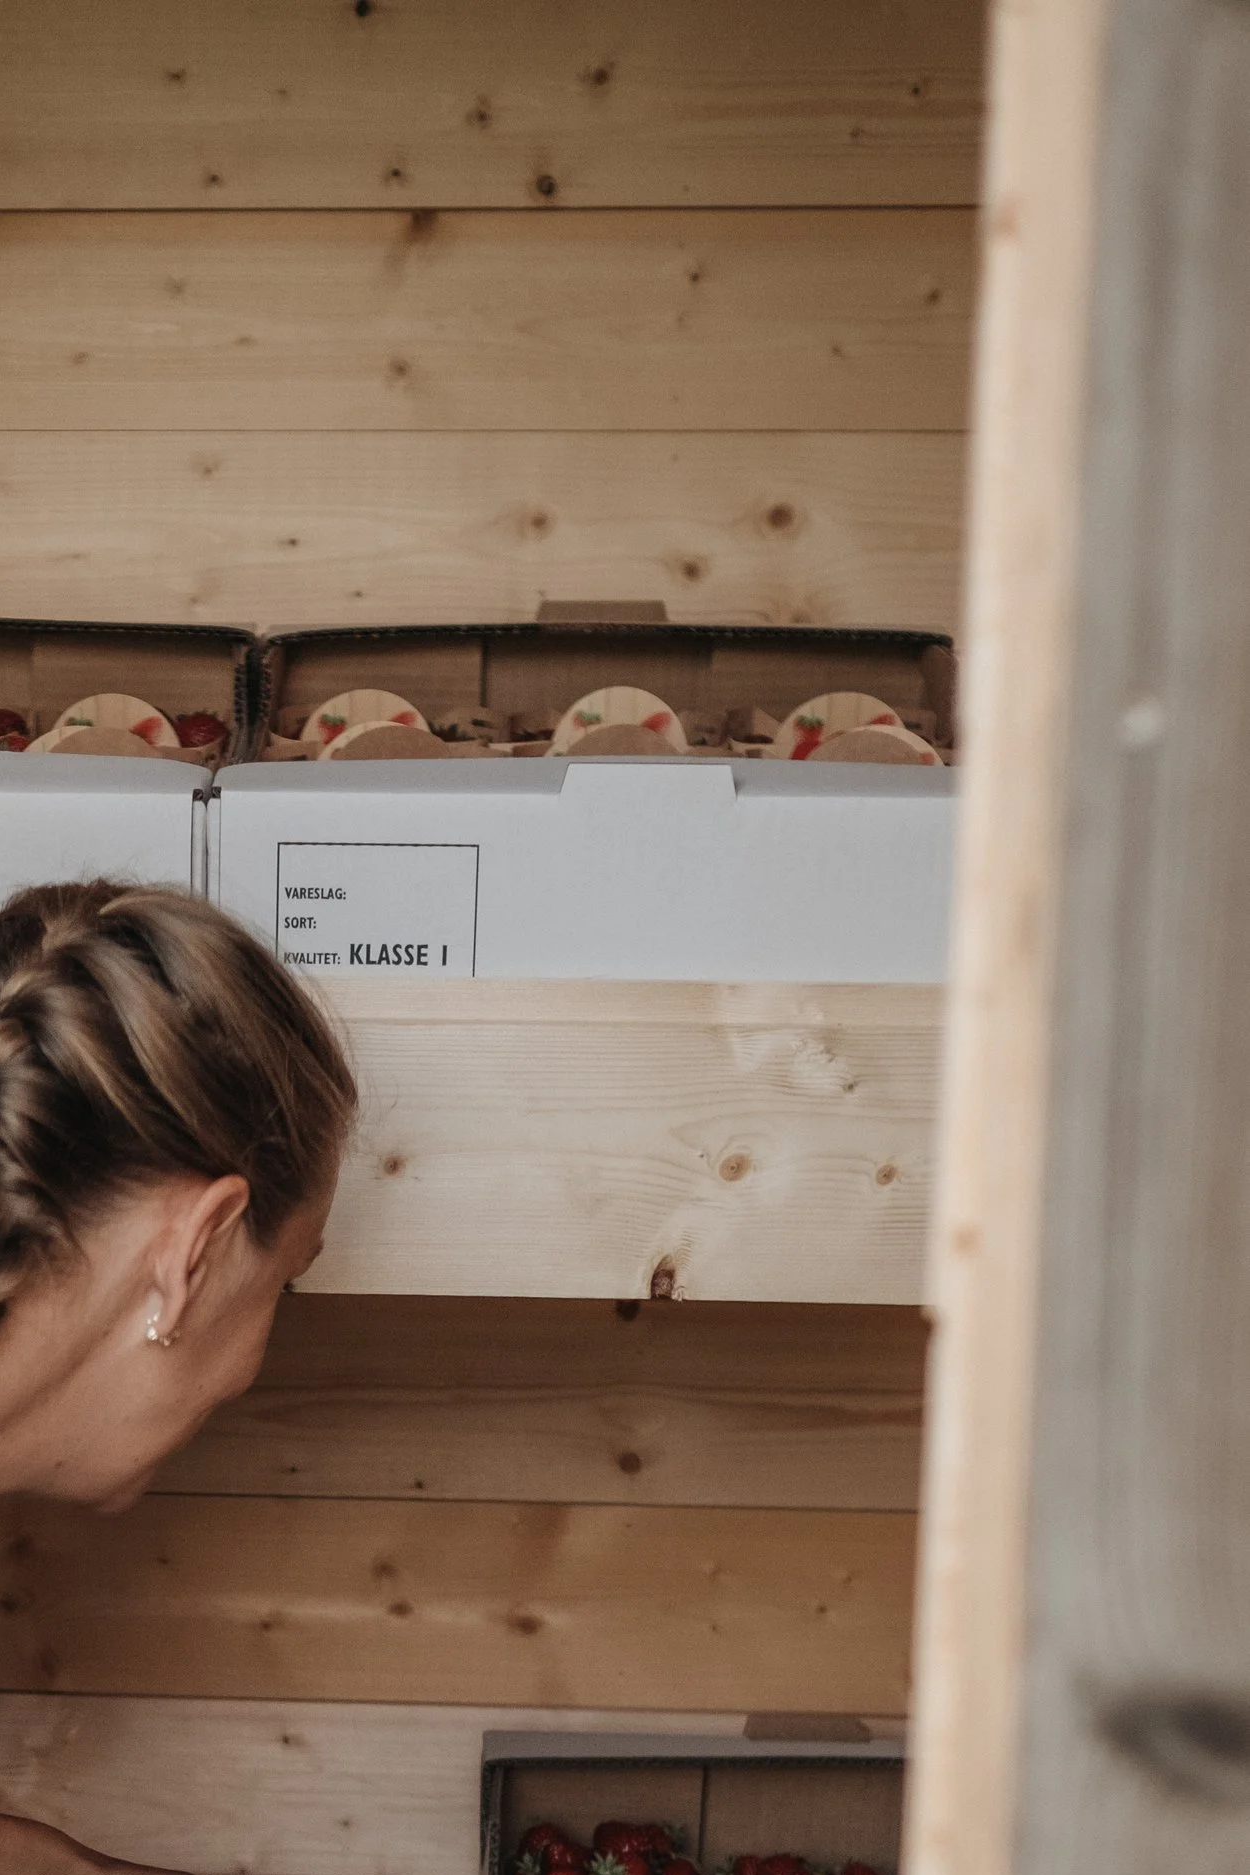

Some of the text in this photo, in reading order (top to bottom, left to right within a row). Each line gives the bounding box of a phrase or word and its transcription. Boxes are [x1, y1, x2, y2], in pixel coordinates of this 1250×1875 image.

[284, 887, 347, 900] VARESLAG:
[284, 916, 317, 929] SORT:
[284, 943, 448, 966] KVALITET: KLASSE I
